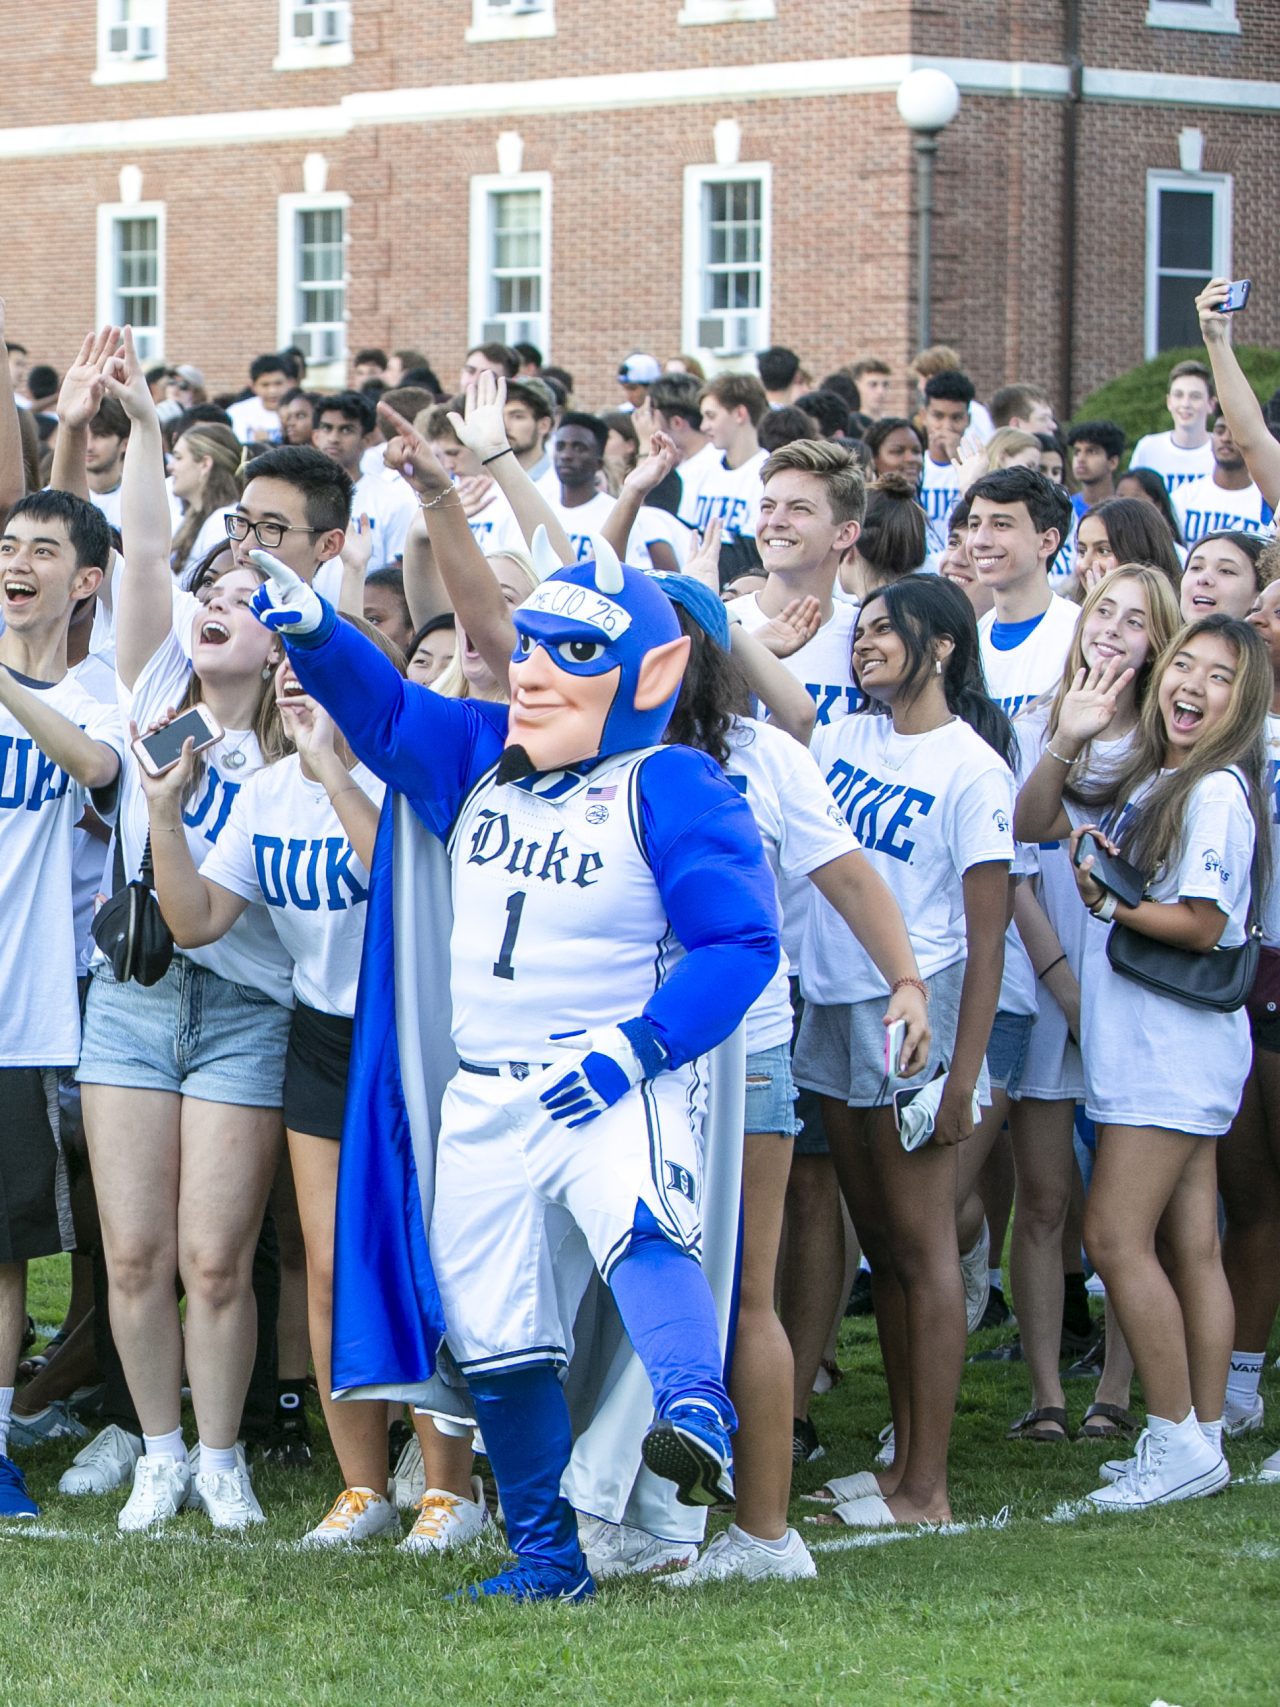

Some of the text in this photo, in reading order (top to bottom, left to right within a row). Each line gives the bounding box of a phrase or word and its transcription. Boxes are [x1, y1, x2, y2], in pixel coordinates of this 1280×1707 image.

[467, 809, 604, 888] Duke
[825, 758, 936, 863] DUKE
[493, 891, 526, 980] 1
